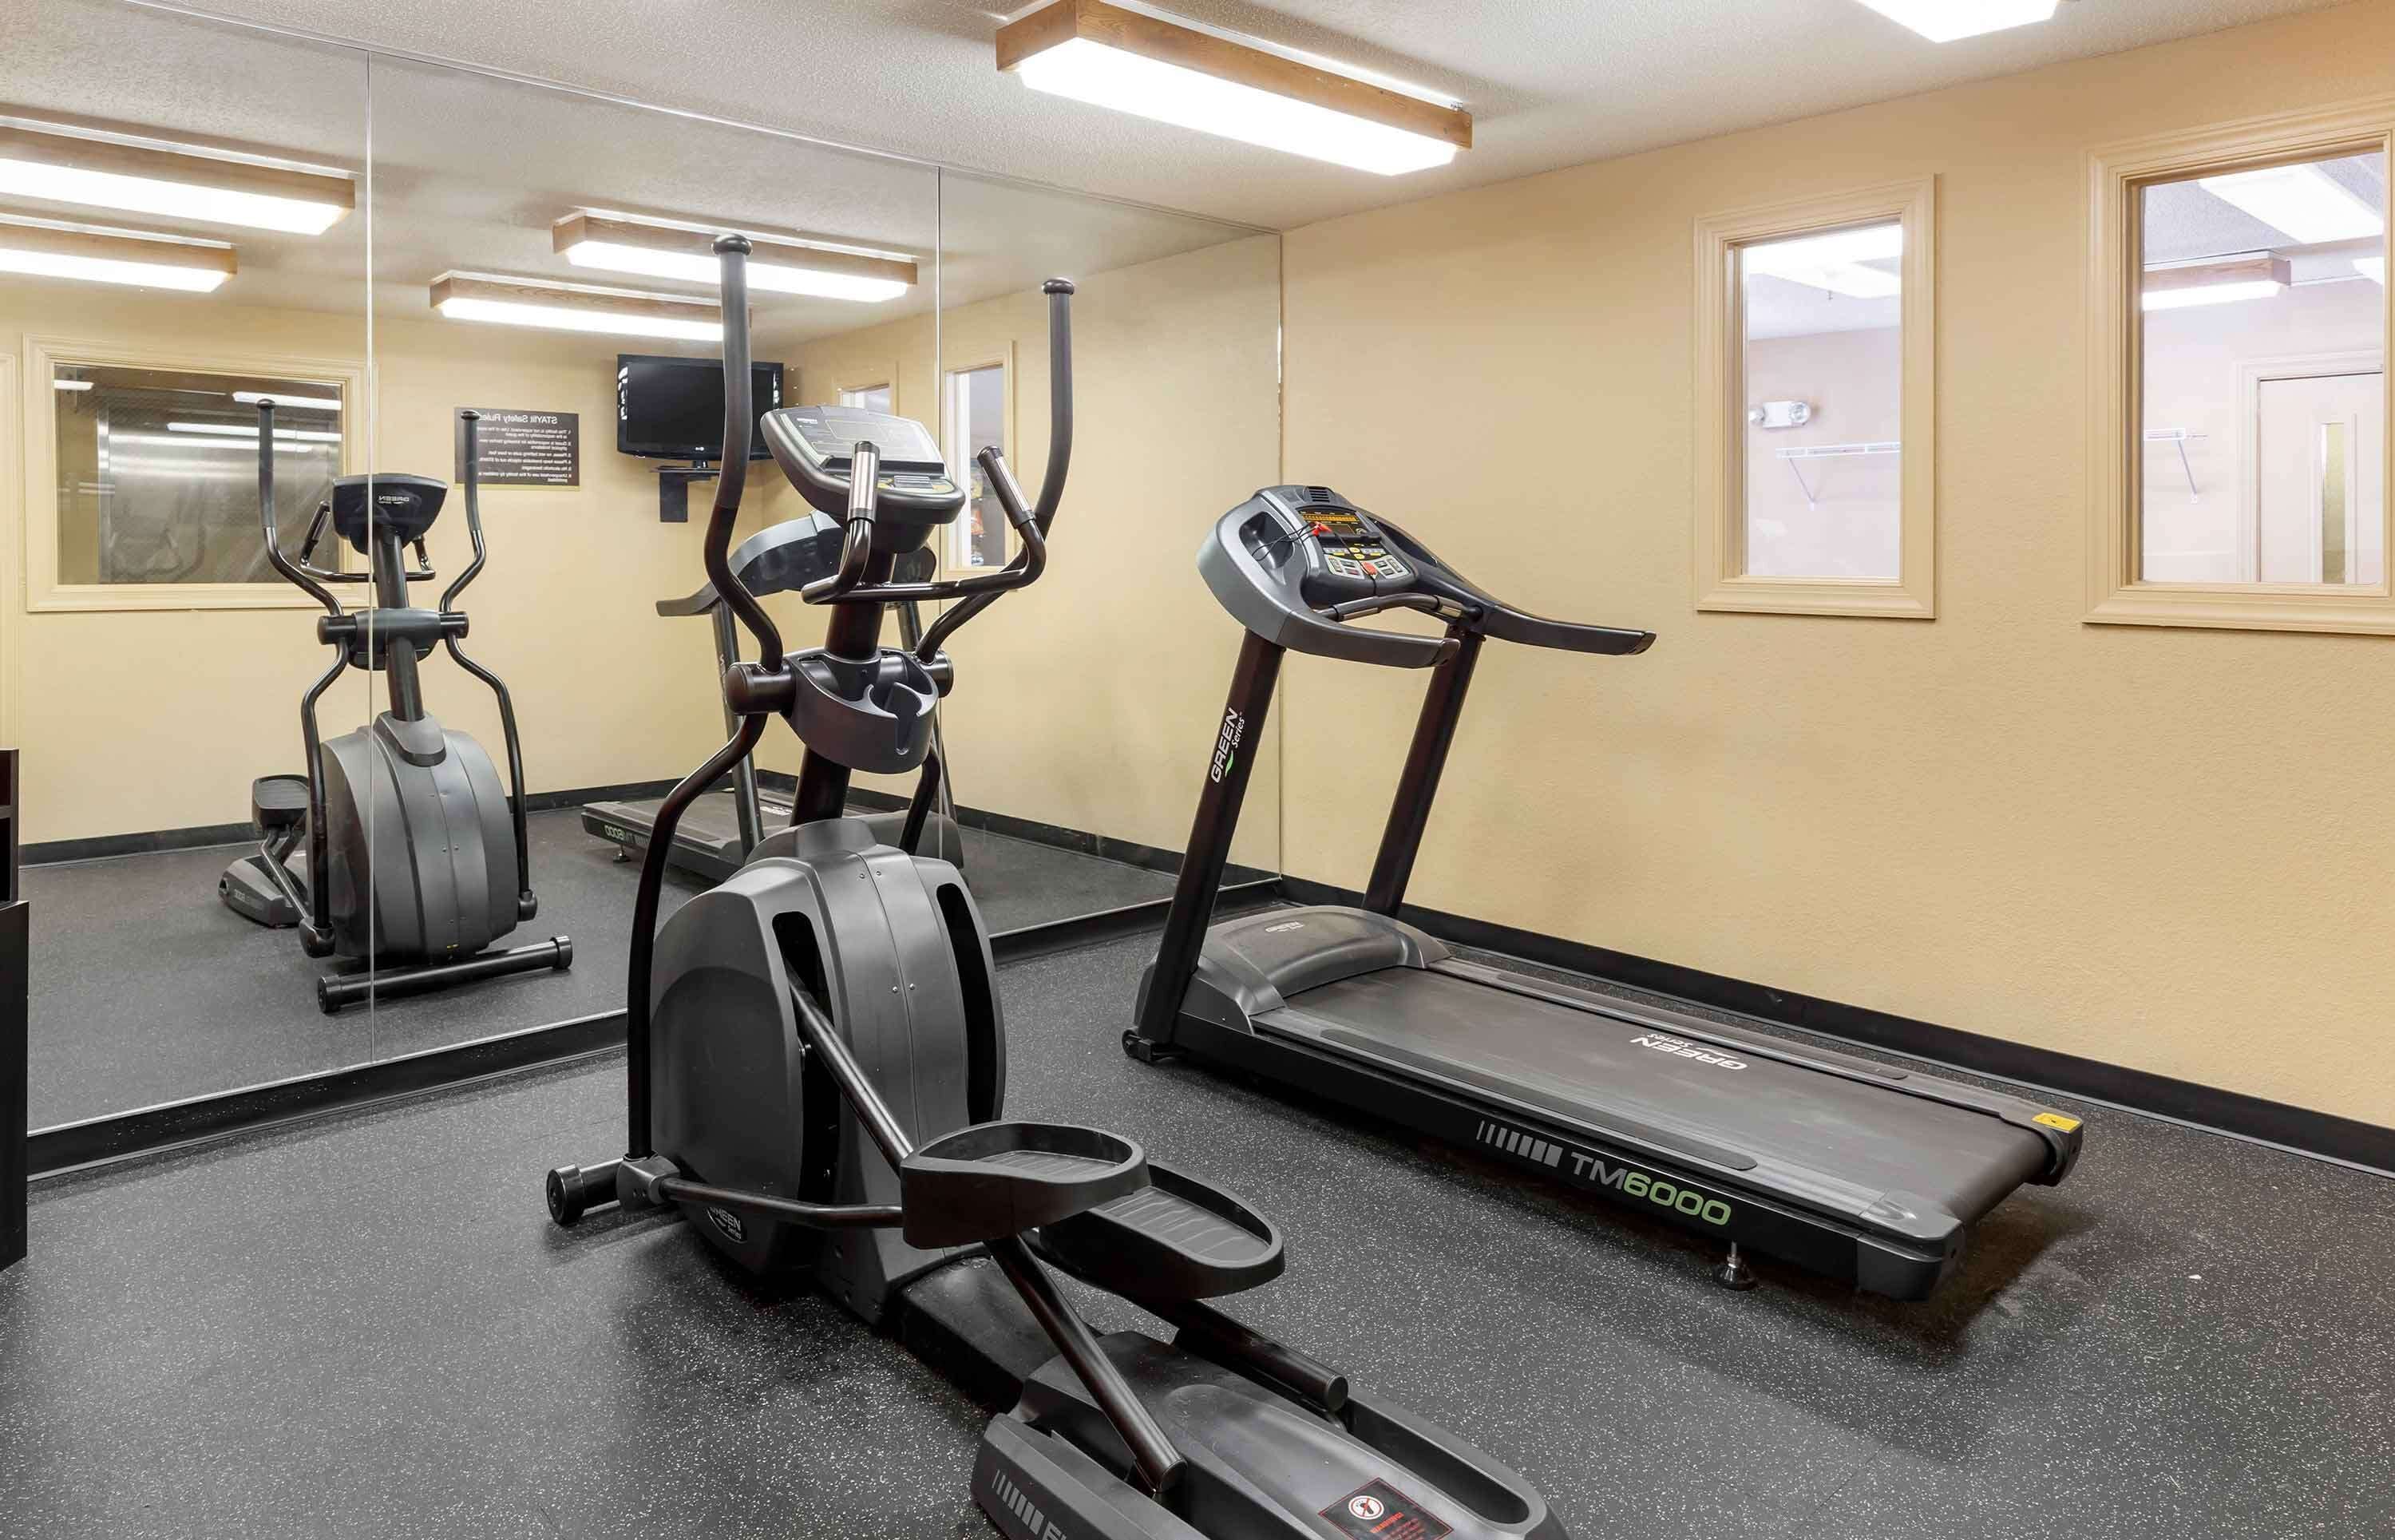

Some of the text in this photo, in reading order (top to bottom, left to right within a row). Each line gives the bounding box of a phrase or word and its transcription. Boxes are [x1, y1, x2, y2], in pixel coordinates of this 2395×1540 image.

[1210, 707, 1238, 783] GREEN
[1231, 716, 1245, 749] Series
[1629, 1037, 1748, 1071] GREEN
[1570, 1151, 1732, 1226] TM6000
